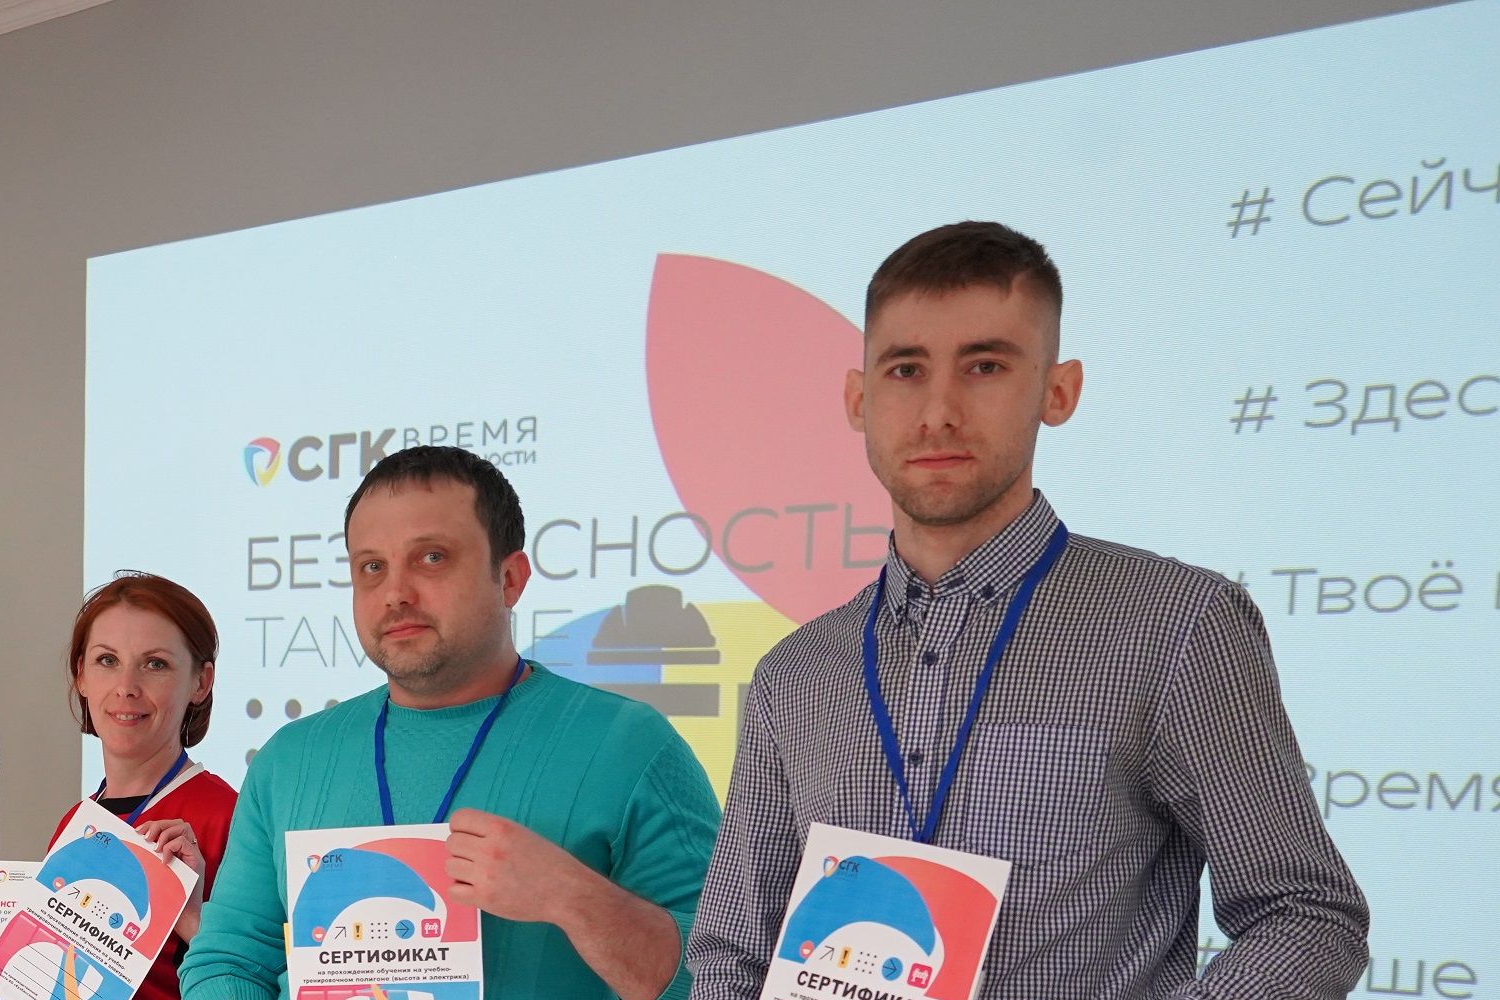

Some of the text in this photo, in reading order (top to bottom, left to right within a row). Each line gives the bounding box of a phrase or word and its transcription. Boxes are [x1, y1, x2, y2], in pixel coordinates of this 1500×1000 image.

[1304, 374, 1500, 435] Здес
[287, 416, 538, 482] СГК ВРЕМЯ
[248, 502, 891, 592] БЕЗСНОСТЬ
[1271, 560, 1464, 617] Твоё
[1302, 761, 1500, 820] рем
[47, 896, 134, 961] СЕРТИФИКАТ
[318, 947, 450, 964] СЕРТИФИКАТ
